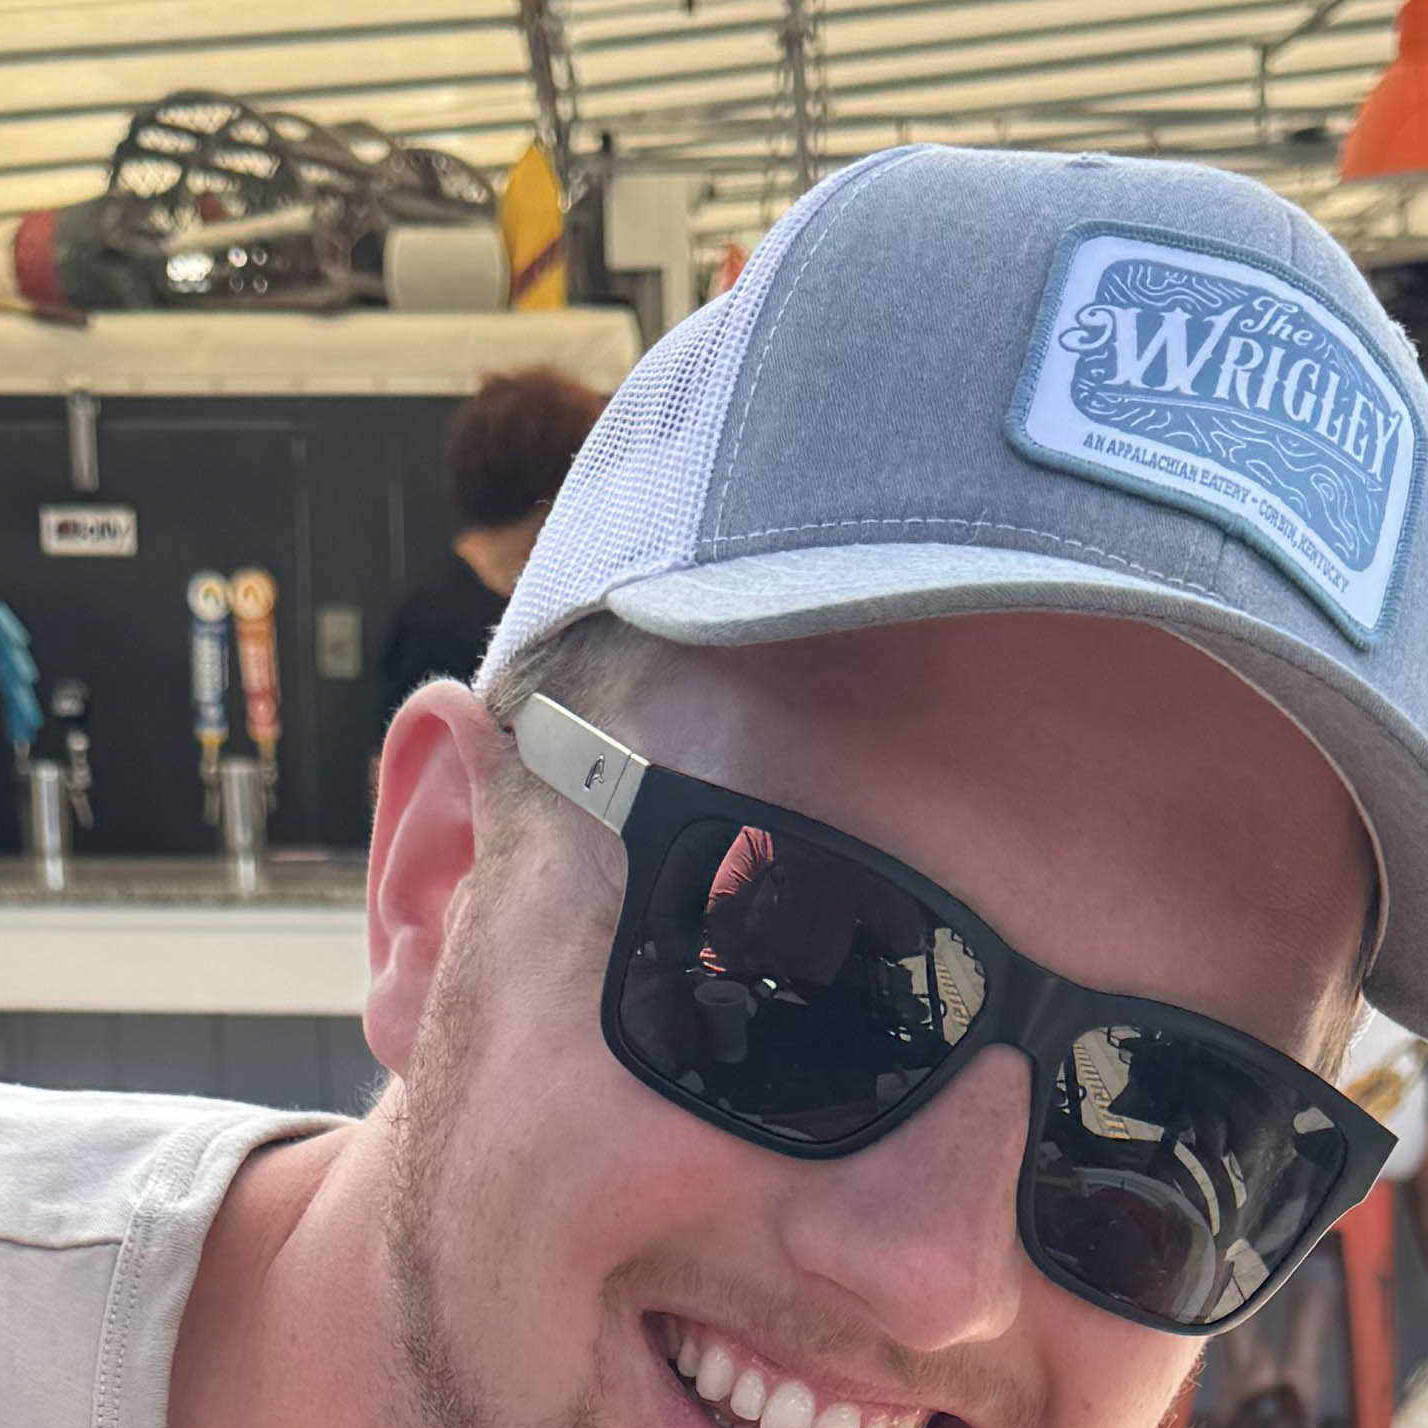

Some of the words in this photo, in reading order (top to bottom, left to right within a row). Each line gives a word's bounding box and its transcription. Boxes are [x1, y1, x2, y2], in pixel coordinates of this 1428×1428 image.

[1059, 303, 1402, 482] WRIGLEY
[1240, 296, 1314, 346] The
[1083, 432, 1106, 452] AN
[1106, 437, 1199, 483] APPALACHIAN
[1200, 469, 1252, 504] EATERY
[1259, 499, 1299, 548] CORBIN,
[1297, 533, 1350, 593] KENTUCKY
